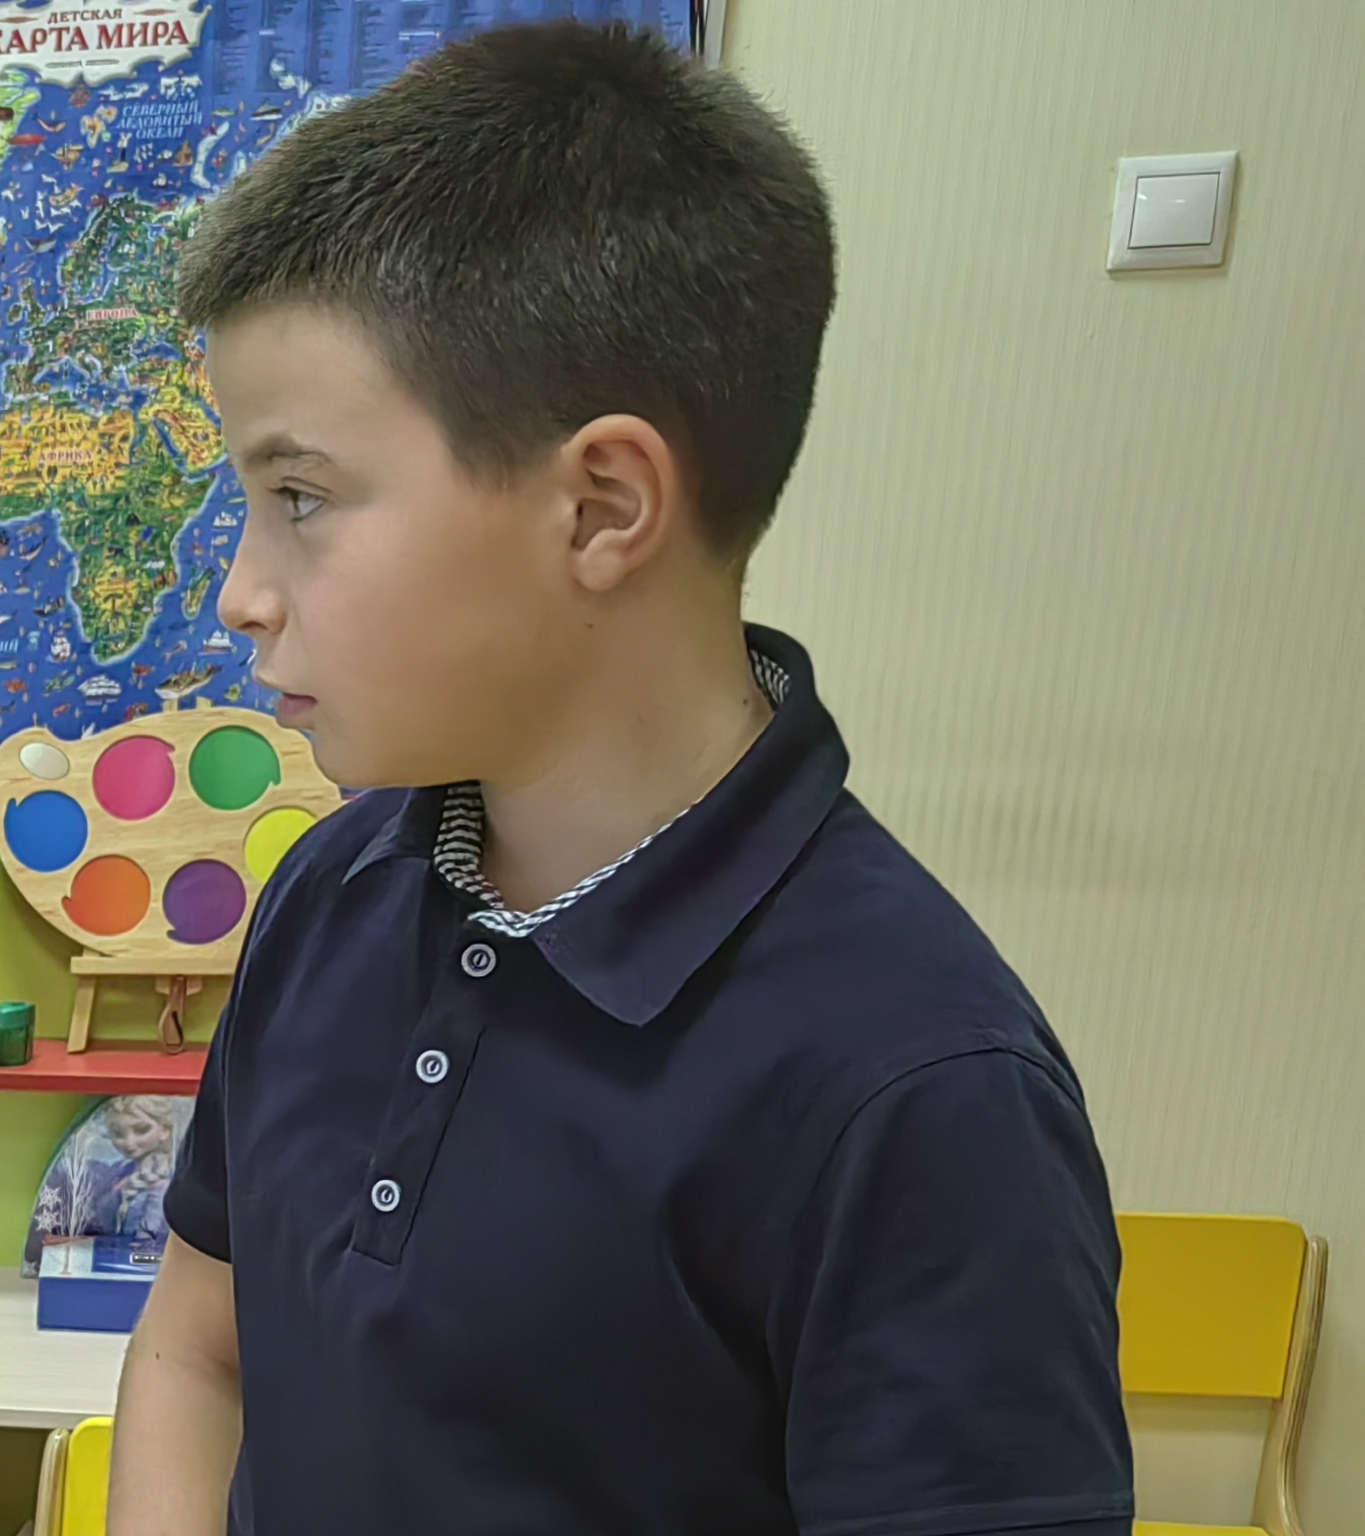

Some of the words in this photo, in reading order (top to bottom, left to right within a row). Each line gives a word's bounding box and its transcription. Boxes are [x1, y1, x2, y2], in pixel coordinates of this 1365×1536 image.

[47, 8, 122, 24] ДЕТСКАЯ
[96, 20, 190, 50] МИРА
[122, 98, 200, 117] СЕВЕРНЫЙ
[115, 111, 203, 130] ЛЕДОВИТЫЙ
[135, 127, 185, 139] ОКЕАН
[39, 450, 92, 462] АФРИКА
